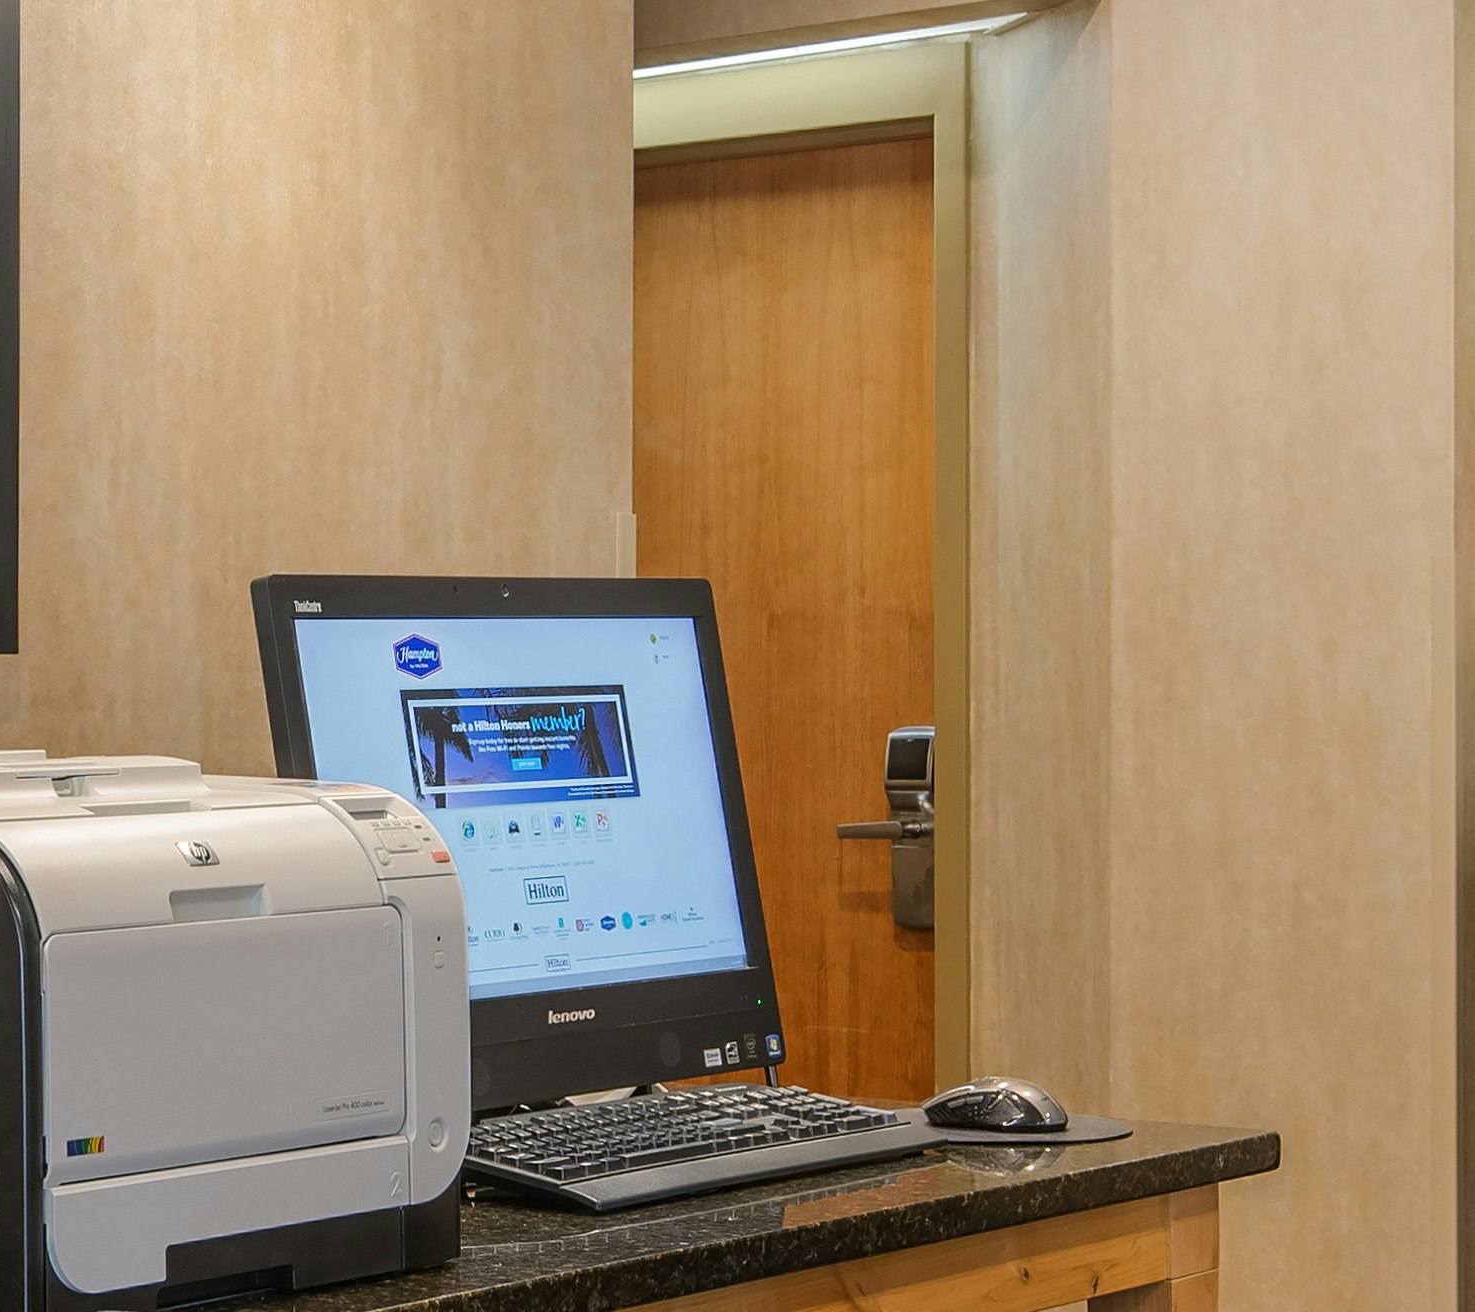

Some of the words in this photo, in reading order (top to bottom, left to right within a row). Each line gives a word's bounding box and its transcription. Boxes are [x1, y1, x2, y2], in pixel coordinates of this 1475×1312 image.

[452, 721, 467, 733] not
[474, 720, 500, 732] Hilton
[501, 719, 531, 731] Honors
[530, 706, 586, 732] member?
[527, 883, 565, 900] Hilton
[548, 1008, 596, 1024] lenovo
